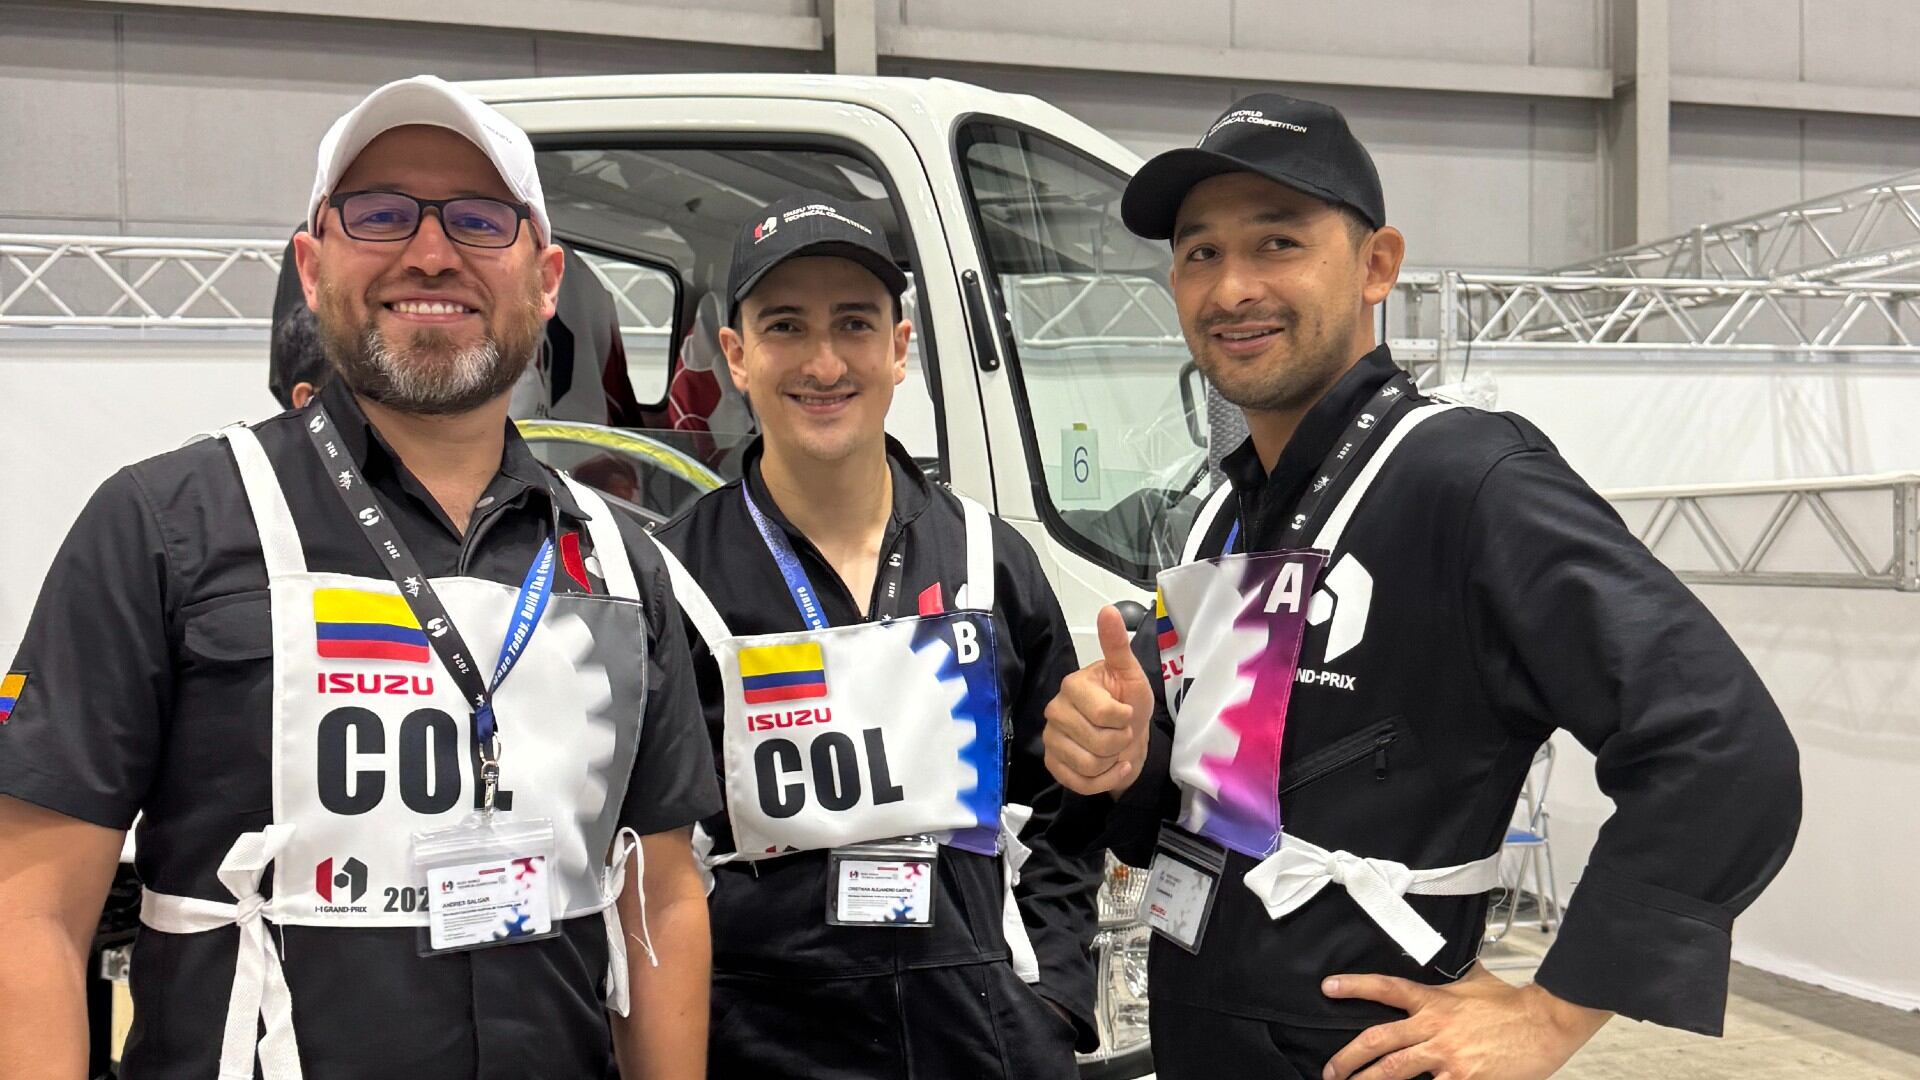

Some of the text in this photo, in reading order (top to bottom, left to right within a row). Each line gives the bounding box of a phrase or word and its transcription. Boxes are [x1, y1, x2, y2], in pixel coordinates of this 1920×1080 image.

[1231, 109, 1263, 117] WORLD
[1246, 116, 1308, 133] COMPETITION
[806, 204, 836, 213] WORLD
[1336, 442, 1353, 460] 2024
[1073, 446, 1089, 483] 6
[384, 540, 401, 559] 2024
[529, 575, 547, 591] The
[1263, 562, 1304, 613] A
[520, 590, 541, 621] Build
[796, 586, 818, 618] Future
[951, 620, 980, 665] B
[317, 673, 434, 695] ISUZU
[747, 707, 833, 733] ISUZU
[317, 706, 514, 816] COL
[754, 727, 905, 819] COL
[383, 886, 430, 913] 202
